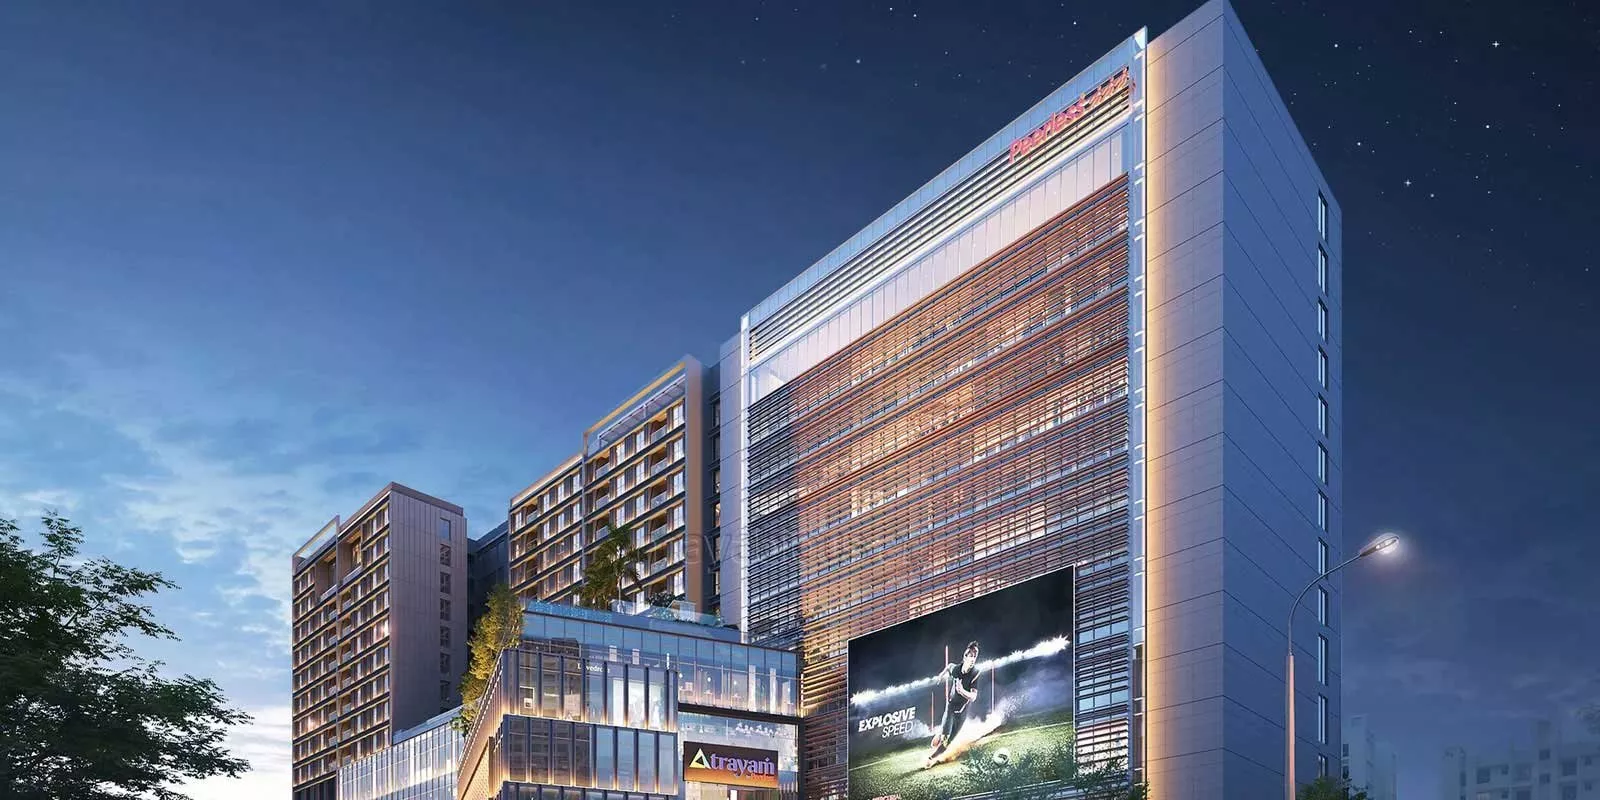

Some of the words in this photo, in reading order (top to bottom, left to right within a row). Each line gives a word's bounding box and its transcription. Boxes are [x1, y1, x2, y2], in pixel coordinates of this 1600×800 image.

[1008, 96, 1086, 163] Peerless
[858, 706, 917, 733] EXPLOSIVE
[881, 720, 914, 739] SPEED
